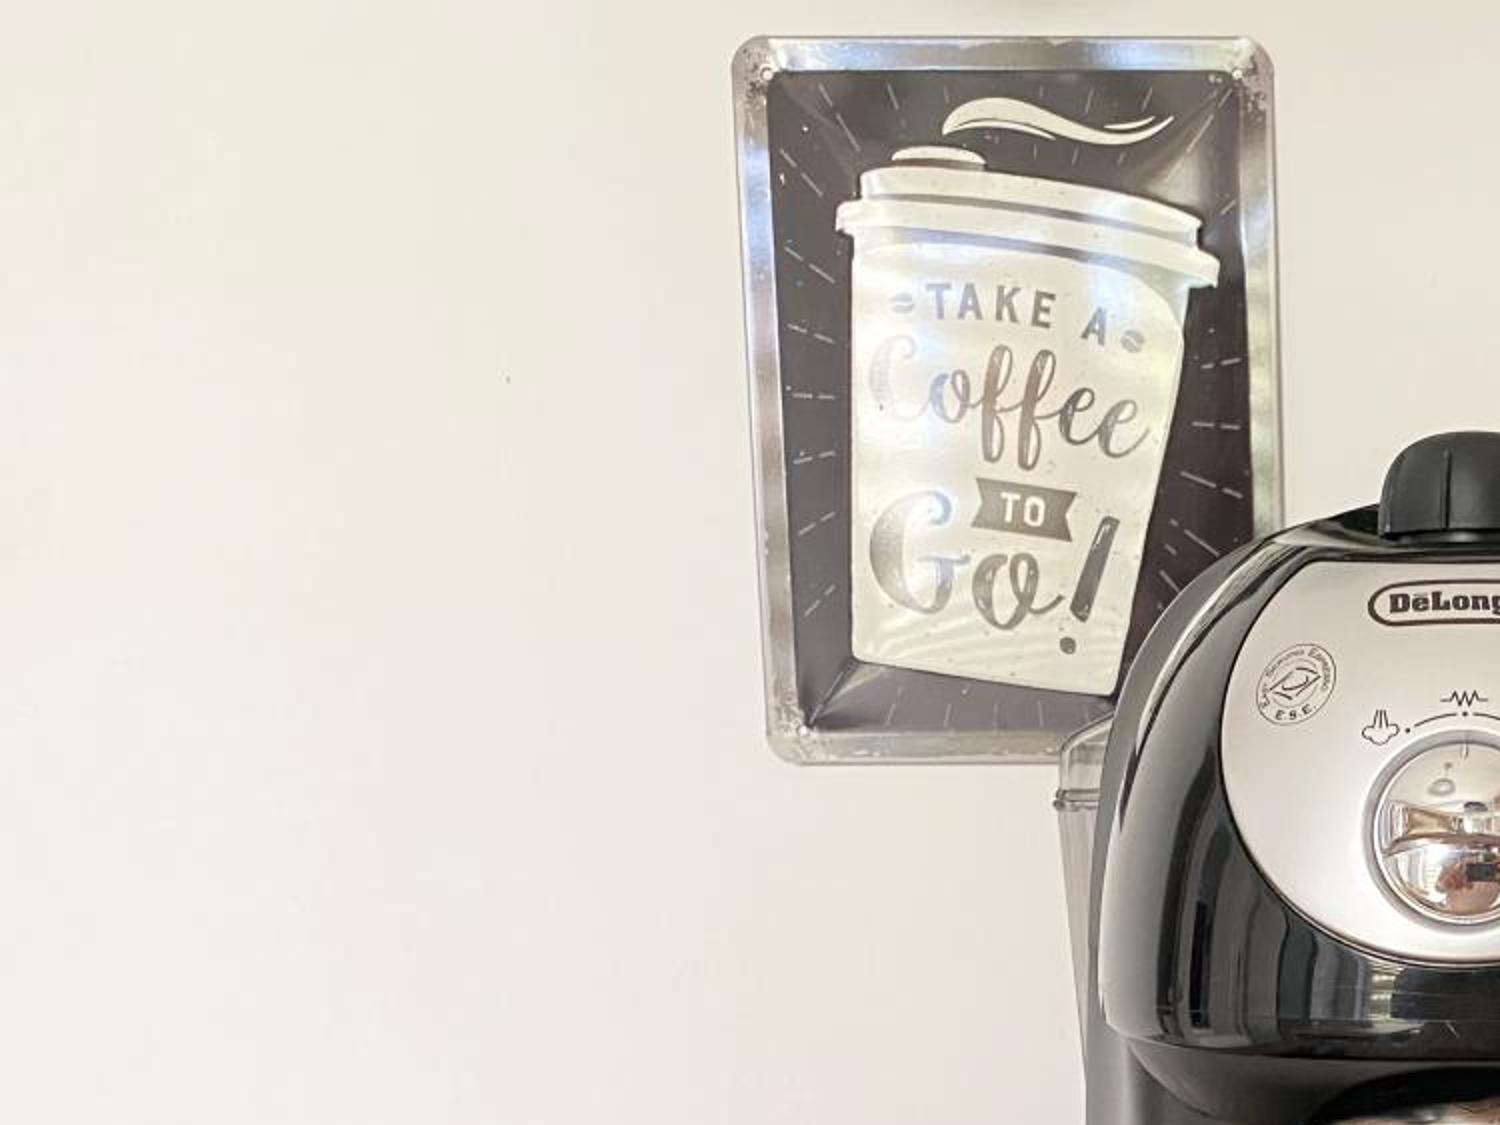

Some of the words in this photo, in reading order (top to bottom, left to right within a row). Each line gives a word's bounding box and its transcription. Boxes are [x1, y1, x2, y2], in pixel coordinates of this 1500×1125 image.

[926, 282, 1056, 329] TAKE
[1080, 307, 1108, 347] A
[868, 334, 1151, 471] Coffee
[1000, 491, 1047, 528] TO
[868, 490, 1121, 655] Go!
